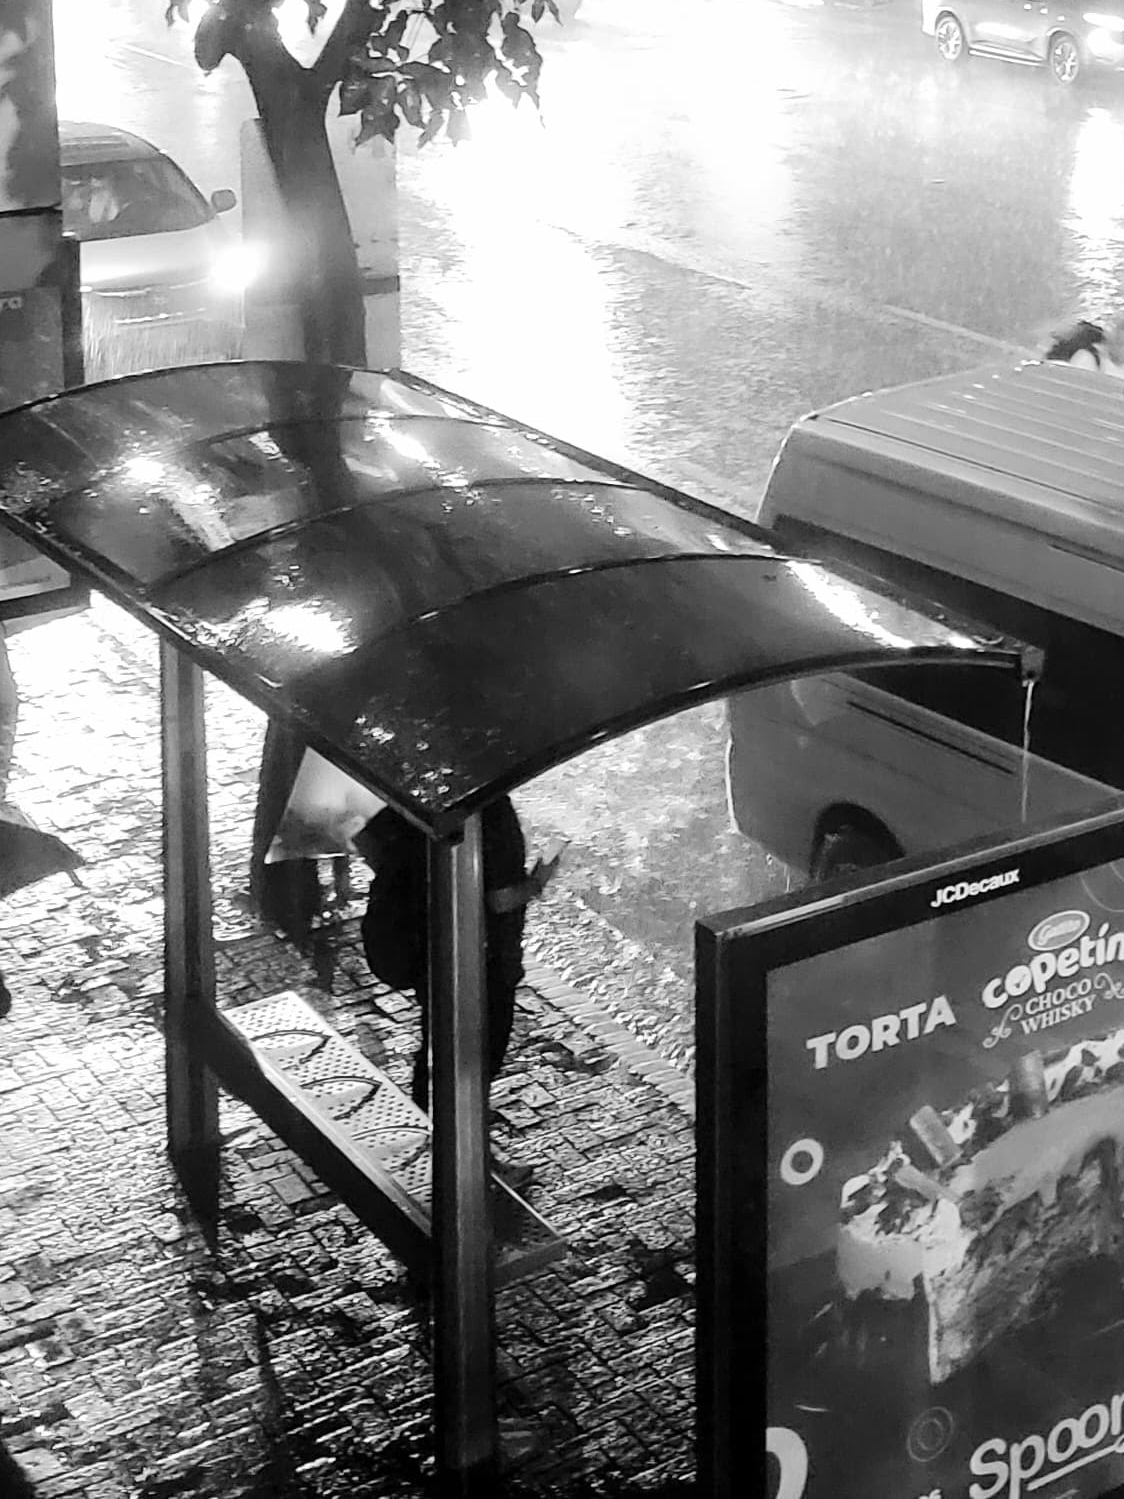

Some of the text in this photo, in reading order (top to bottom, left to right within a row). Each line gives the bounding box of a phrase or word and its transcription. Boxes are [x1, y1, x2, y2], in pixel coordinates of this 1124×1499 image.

[930, 868, 1020, 908] JCDecaux
[1020, 994, 1097, 1035] WHISKY
[1025, 978, 1092, 1015] CHOCO
[806, 994, 957, 1070] TORTA
